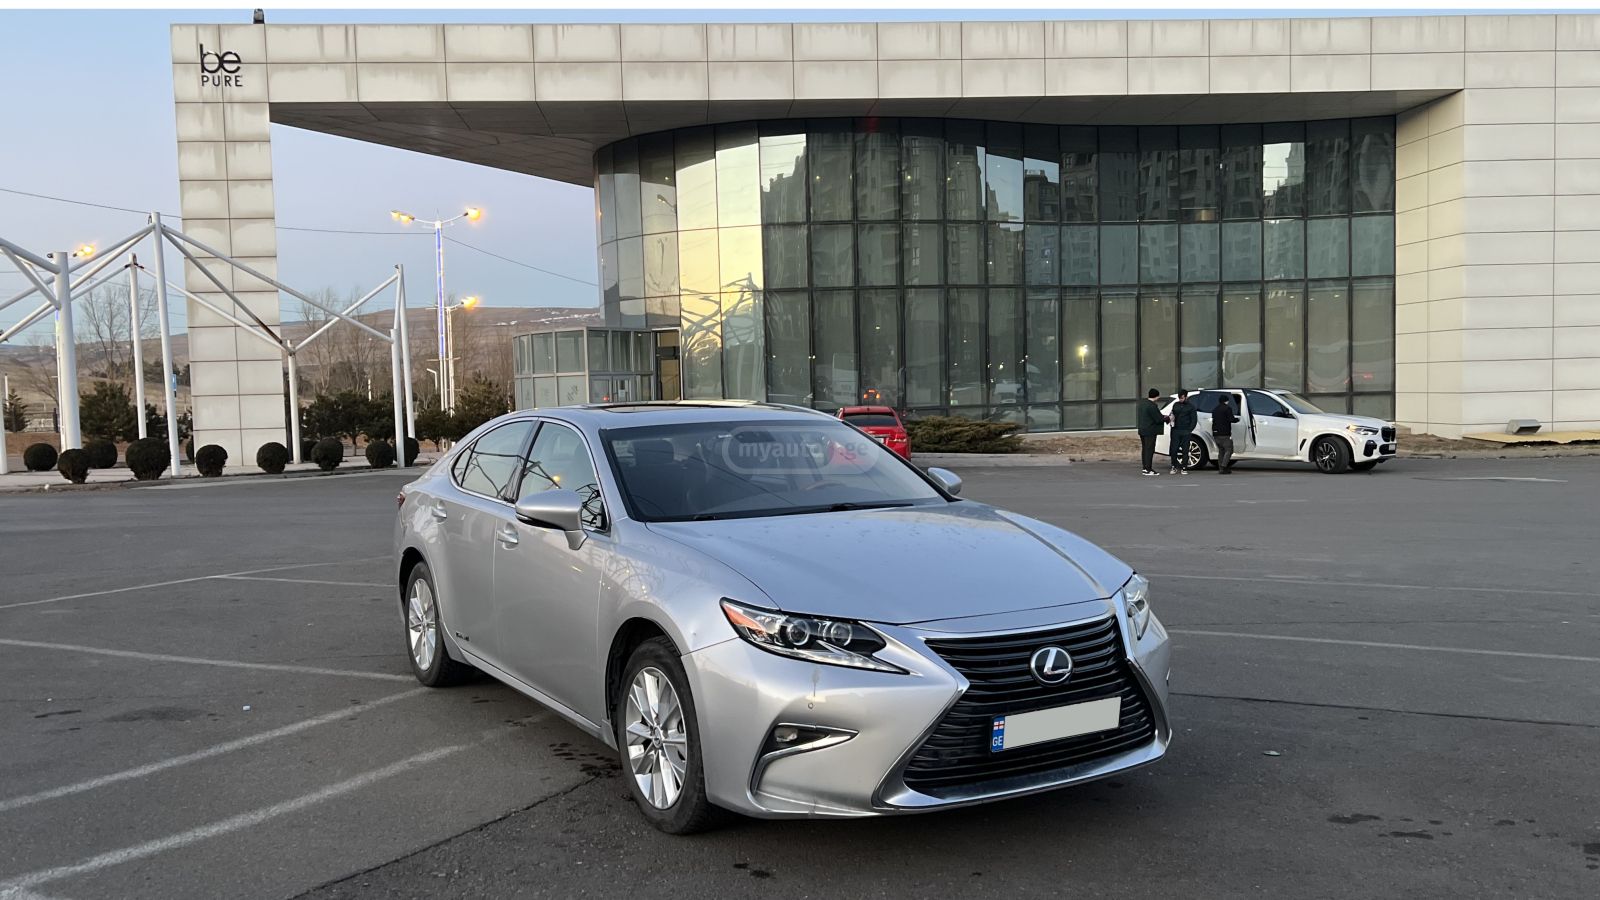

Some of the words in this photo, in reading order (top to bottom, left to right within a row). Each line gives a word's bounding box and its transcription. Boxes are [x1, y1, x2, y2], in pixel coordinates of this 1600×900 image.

[200, 43, 241, 73] be
[201, 75, 242, 87] PURE
[992, 735, 1003, 747] GE
